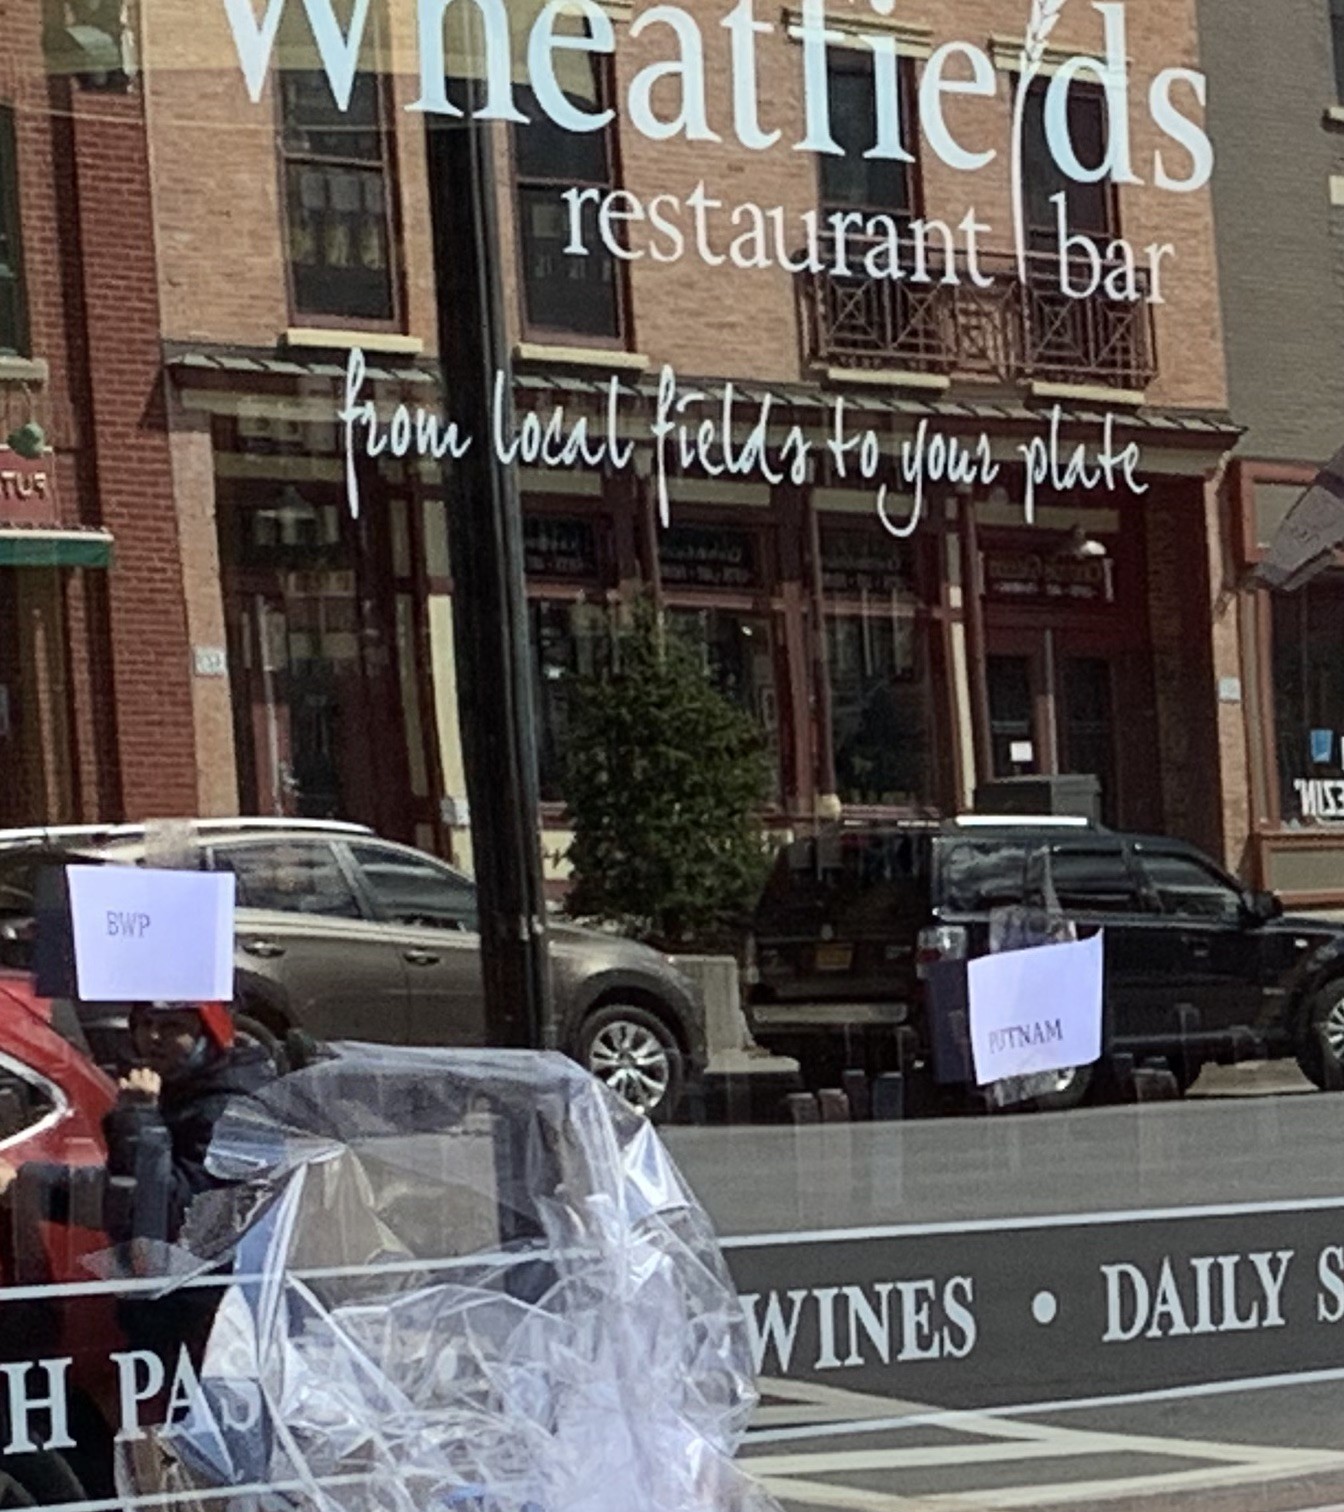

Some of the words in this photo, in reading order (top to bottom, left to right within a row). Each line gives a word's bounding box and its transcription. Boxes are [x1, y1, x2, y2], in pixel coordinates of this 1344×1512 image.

[561, 179, 994, 289] restaurant
[1056, 191, 1176, 305] bar
[336, 345, 472, 519] from
[491, 370, 635, 469] local
[648, 363, 811, 527] fields
[828, 397, 878, 480] to
[877, 417, 1000, 538] your
[1015, 403, 1149, 524] plate
[738, 1274, 978, 1376] WINES
[1100, 1249, 1295, 1342] DAILY
